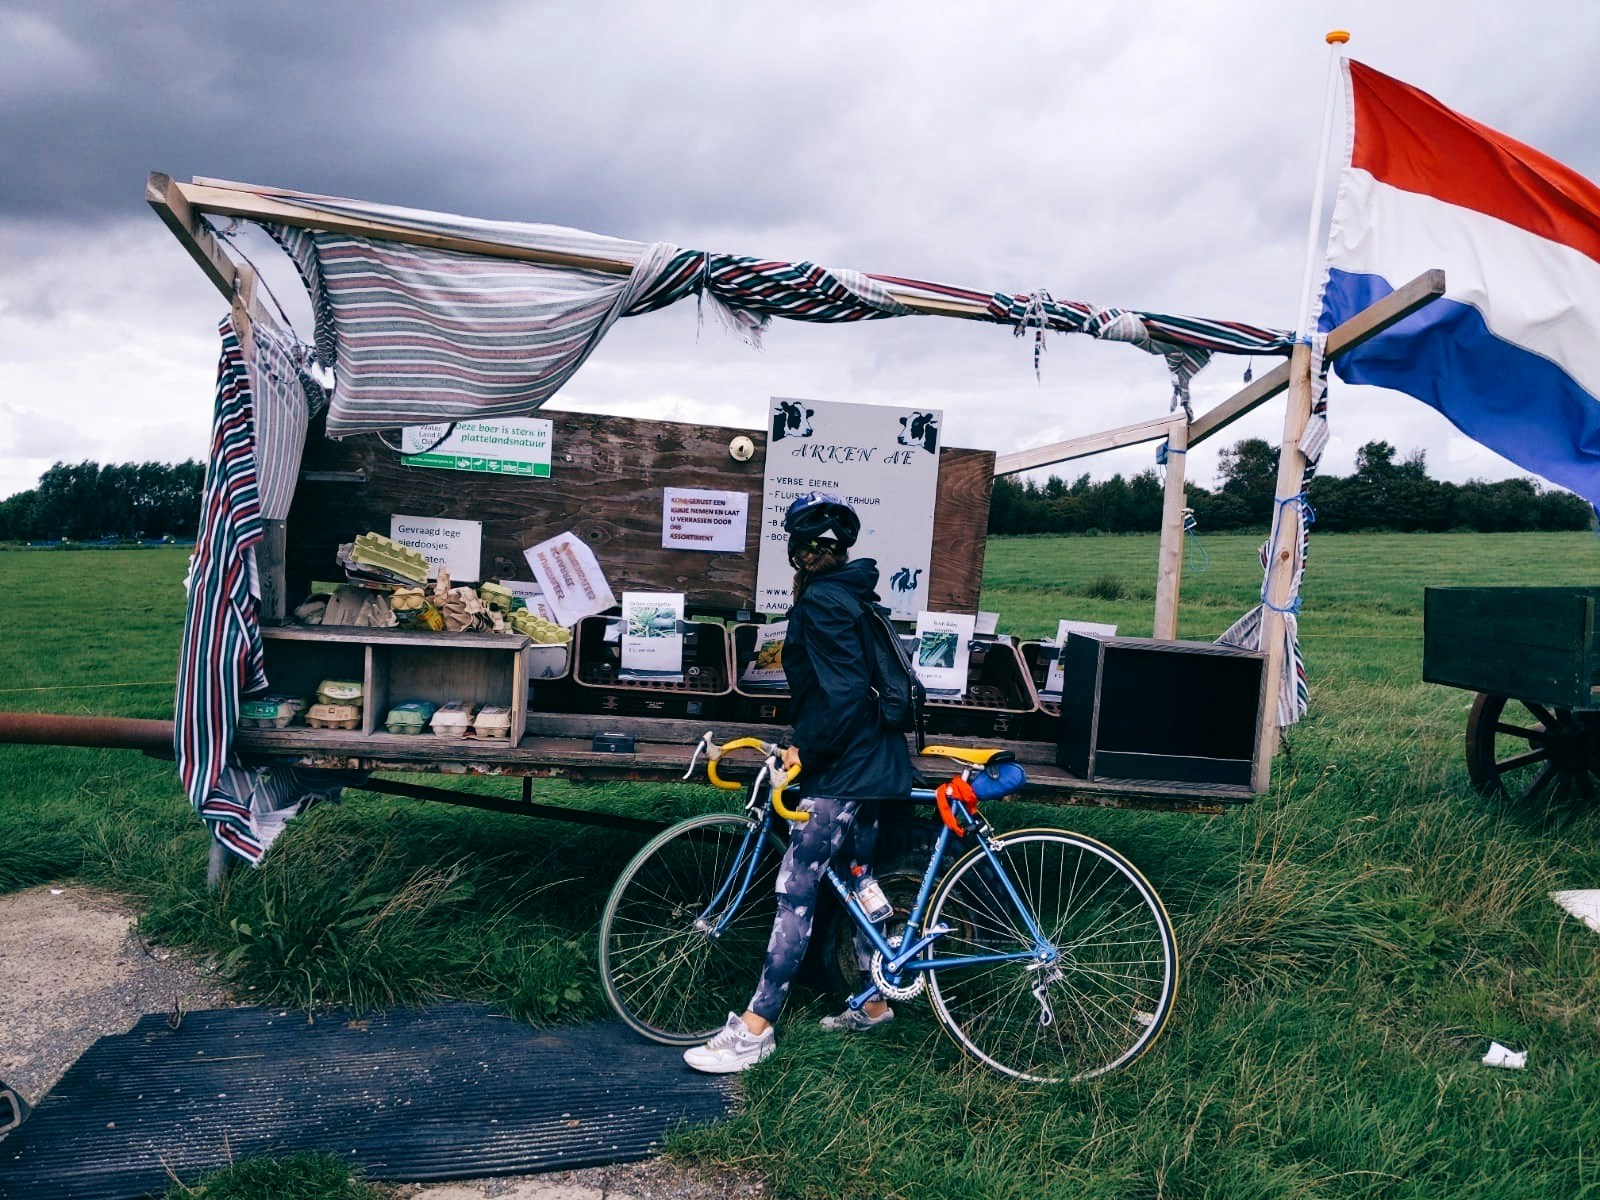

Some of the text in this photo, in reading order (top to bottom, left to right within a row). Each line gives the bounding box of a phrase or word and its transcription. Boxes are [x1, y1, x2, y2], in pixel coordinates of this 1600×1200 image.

[455, 422, 476, 432] Deze
[479, 422, 498, 433] boer
[502, 424, 509, 434] is
[537, 429, 546, 438] in
[461, 433, 546, 448] plattelandsnatuur
[808, 479, 839, 488] EIEREN
[689, 498, 712, 506] GERUST
[398, 525, 461, 539] Gevraagd lege
